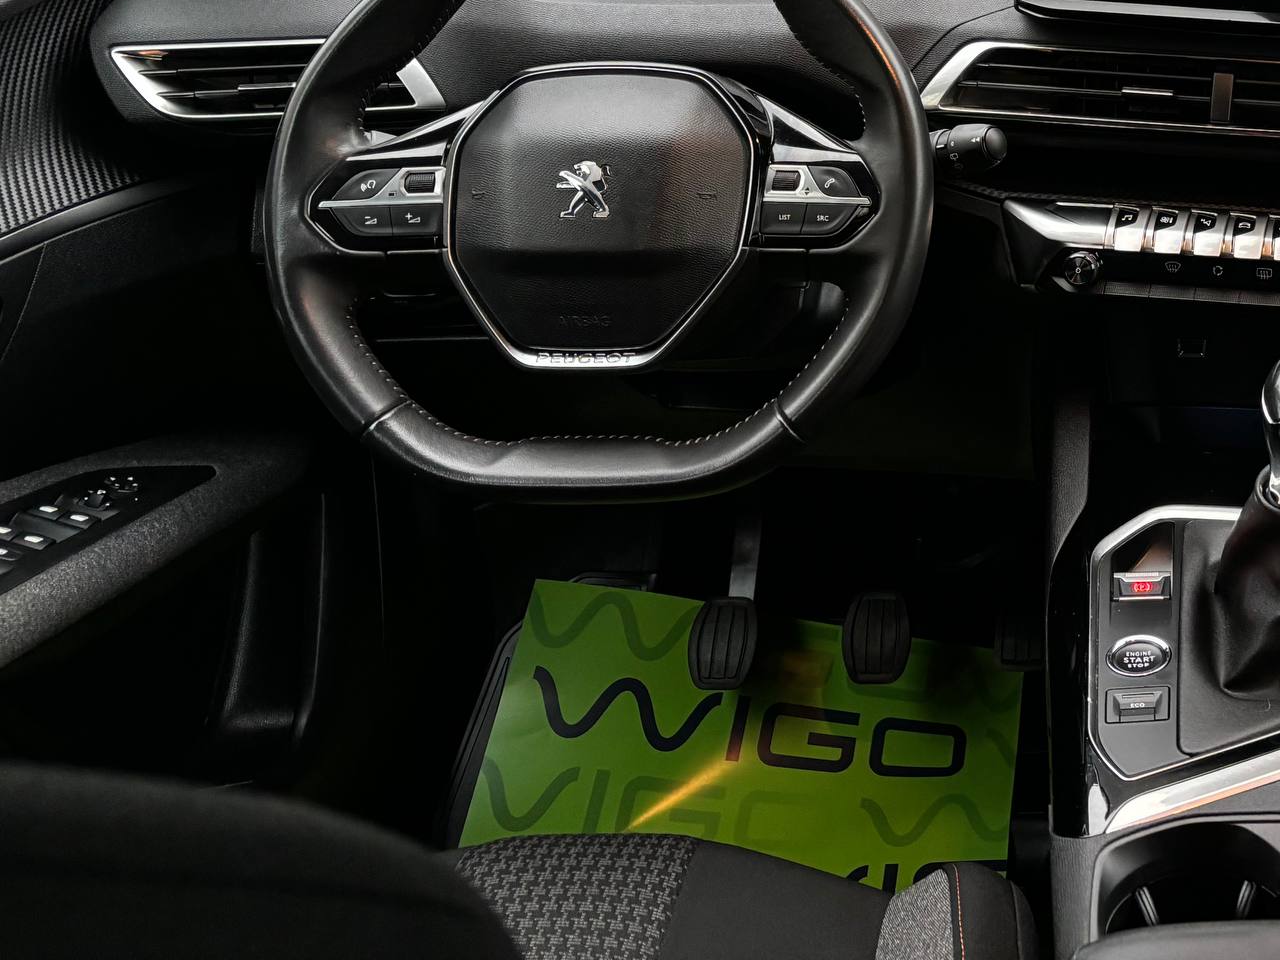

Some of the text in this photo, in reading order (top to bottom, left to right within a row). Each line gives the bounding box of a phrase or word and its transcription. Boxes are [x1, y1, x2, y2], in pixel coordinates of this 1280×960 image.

[535, 351, 637, 366] PEUGEOT
[1123, 655, 1156, 664] START
[533, 665, 967, 778] WIGO
